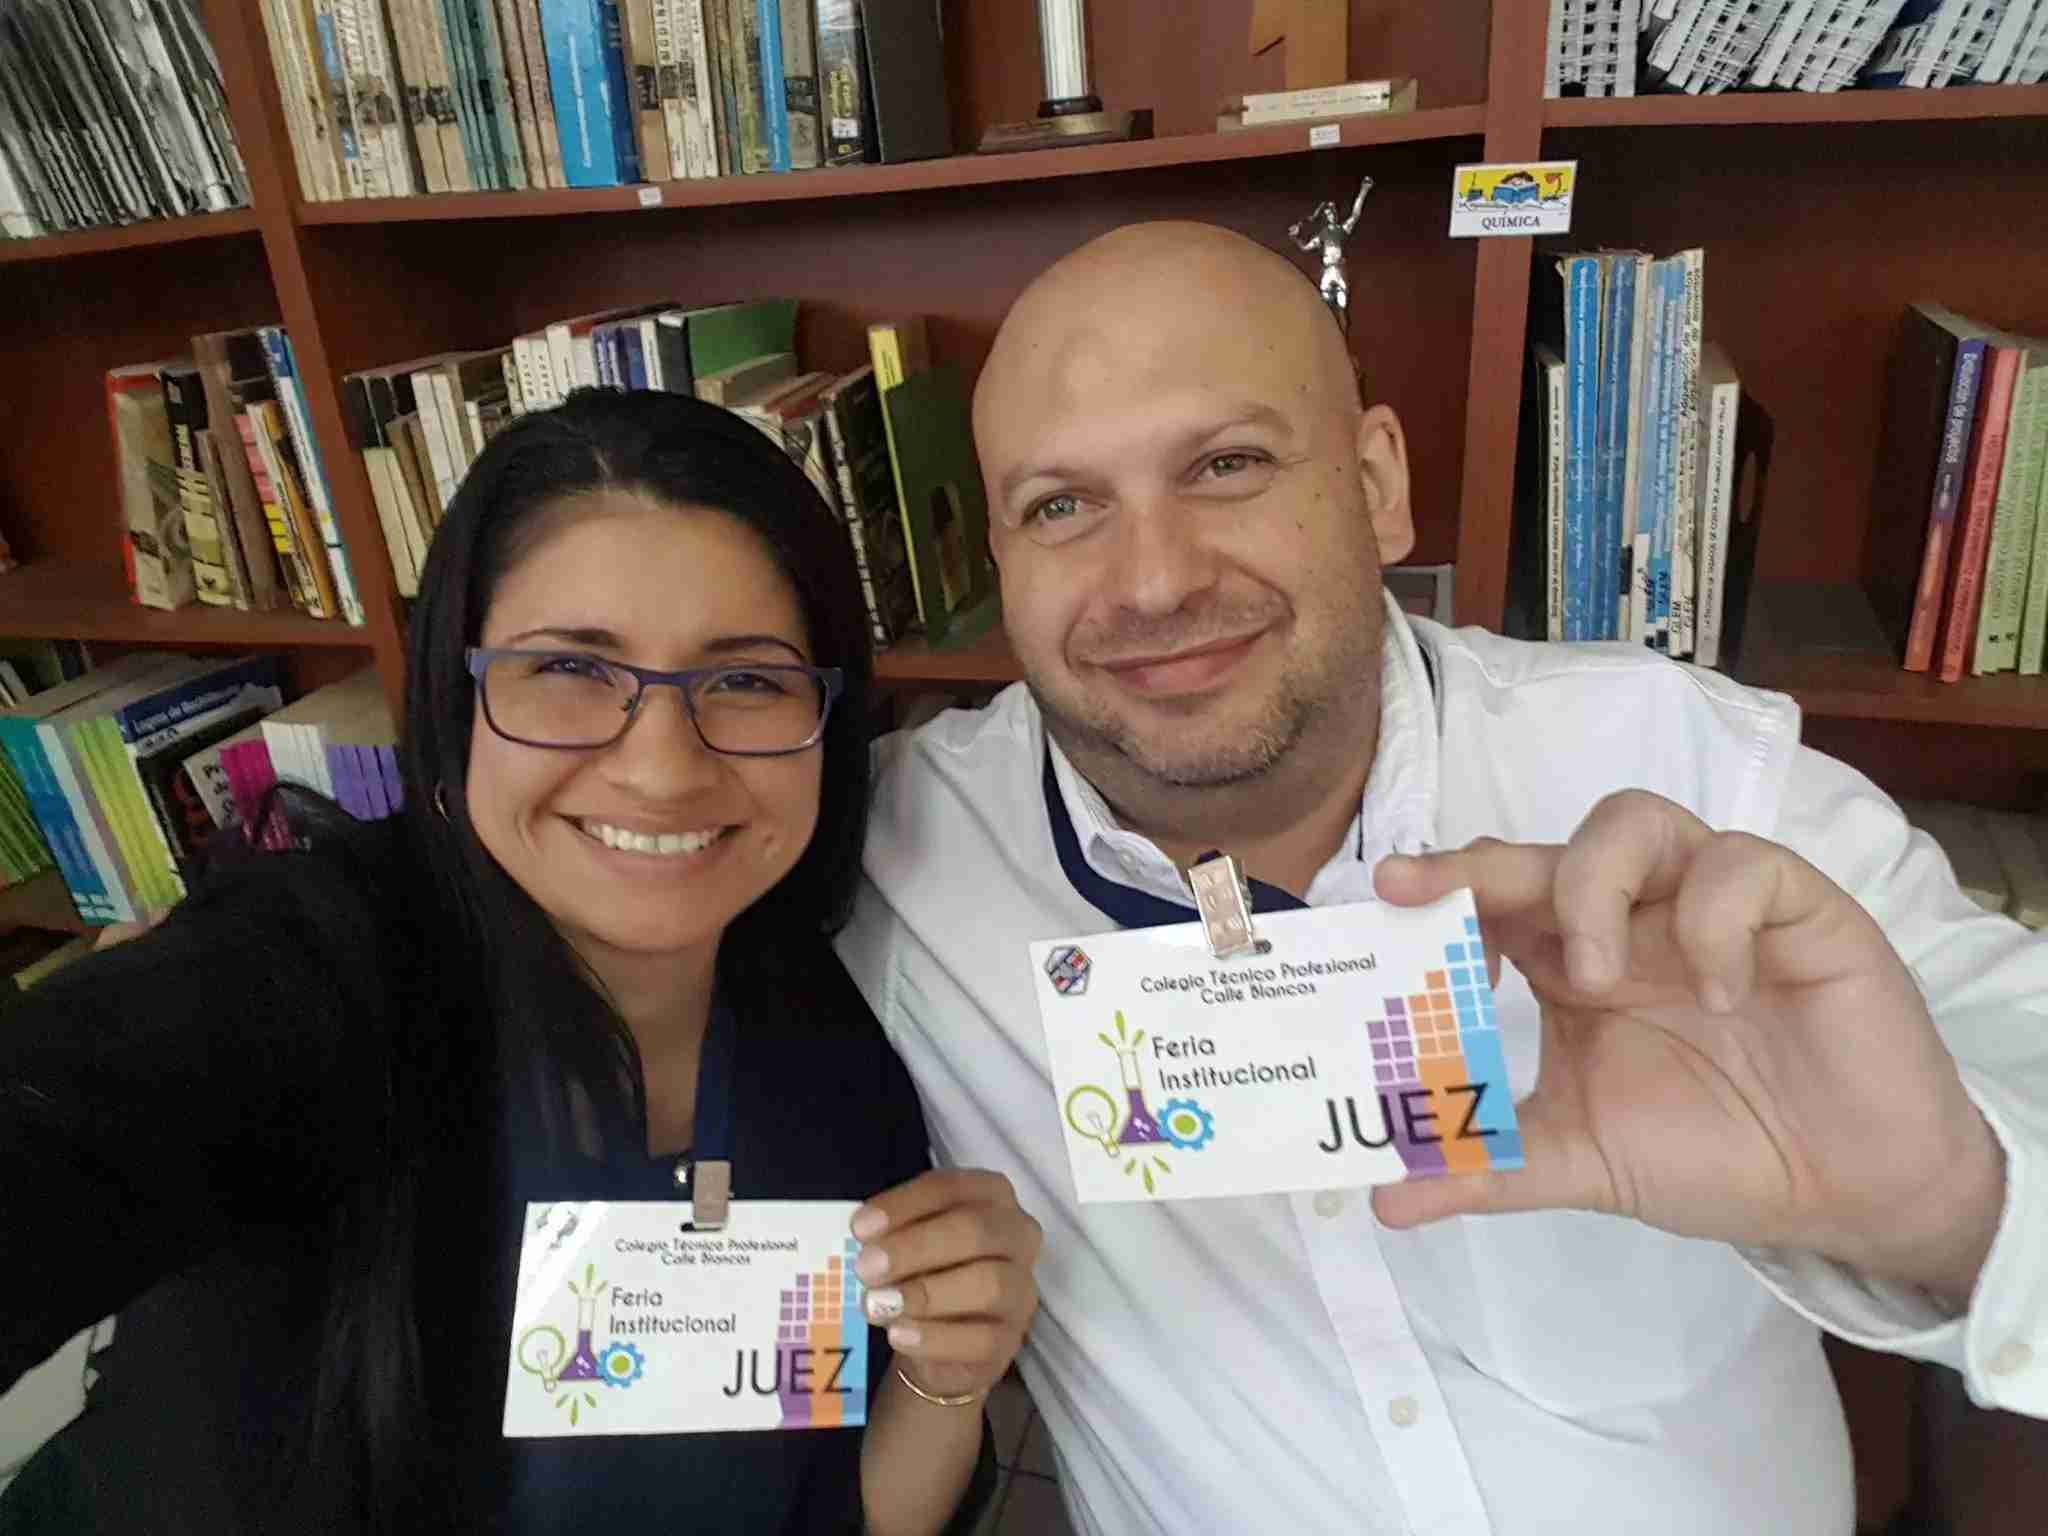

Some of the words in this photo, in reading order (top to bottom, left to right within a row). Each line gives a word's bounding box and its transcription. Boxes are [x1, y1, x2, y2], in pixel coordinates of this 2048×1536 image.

[1140, 974, 1205, 993] Colegio
[1280, 952, 1377, 979] Profesional
[1200, 987, 1244, 1004] Calle
[1249, 981, 1317, 1001] Blancos
[1152, 1035, 1216, 1060] Feria
[1159, 1056, 1317, 1091] Institucional
[1318, 1082, 1499, 1153] JUEZ
[615, 1238, 668, 1253] Colegio
[727, 1237, 799, 1252] Profesional
[611, 1286, 663, 1307] Feria
[609, 1312, 737, 1334] Institucional
[722, 1347, 854, 1397] JUEZ
